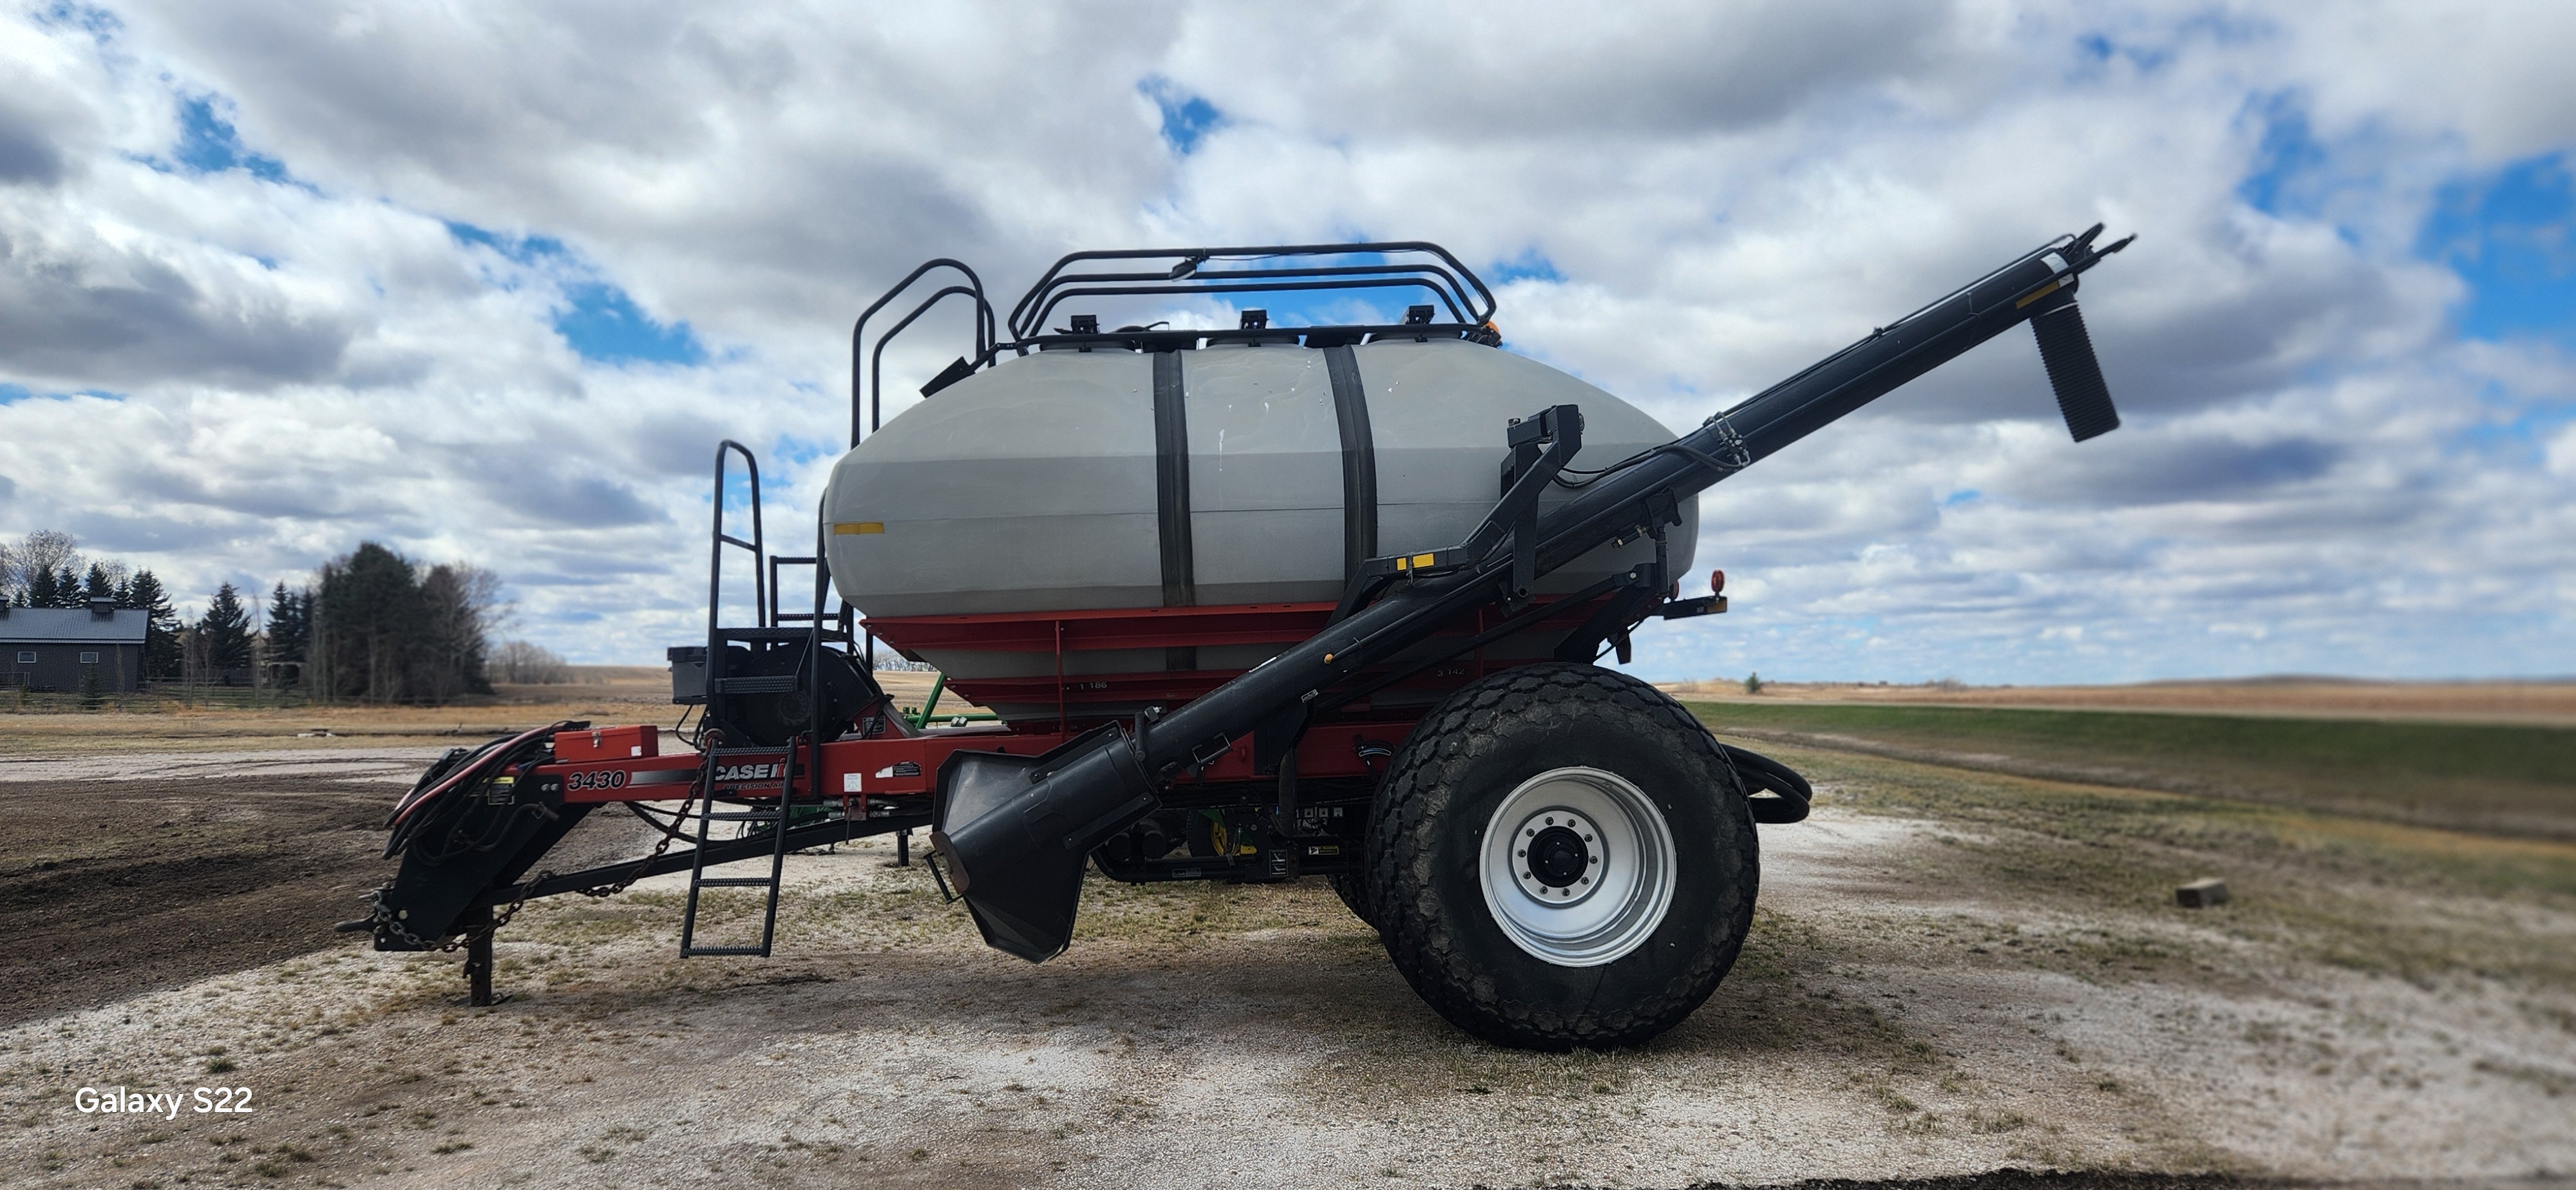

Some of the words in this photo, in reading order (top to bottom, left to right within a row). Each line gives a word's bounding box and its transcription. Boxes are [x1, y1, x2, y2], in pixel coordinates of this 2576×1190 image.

[567, 770, 627, 791] 3430
[715, 764, 770, 781] CASE
[724, 782, 770, 791] PRECISION
